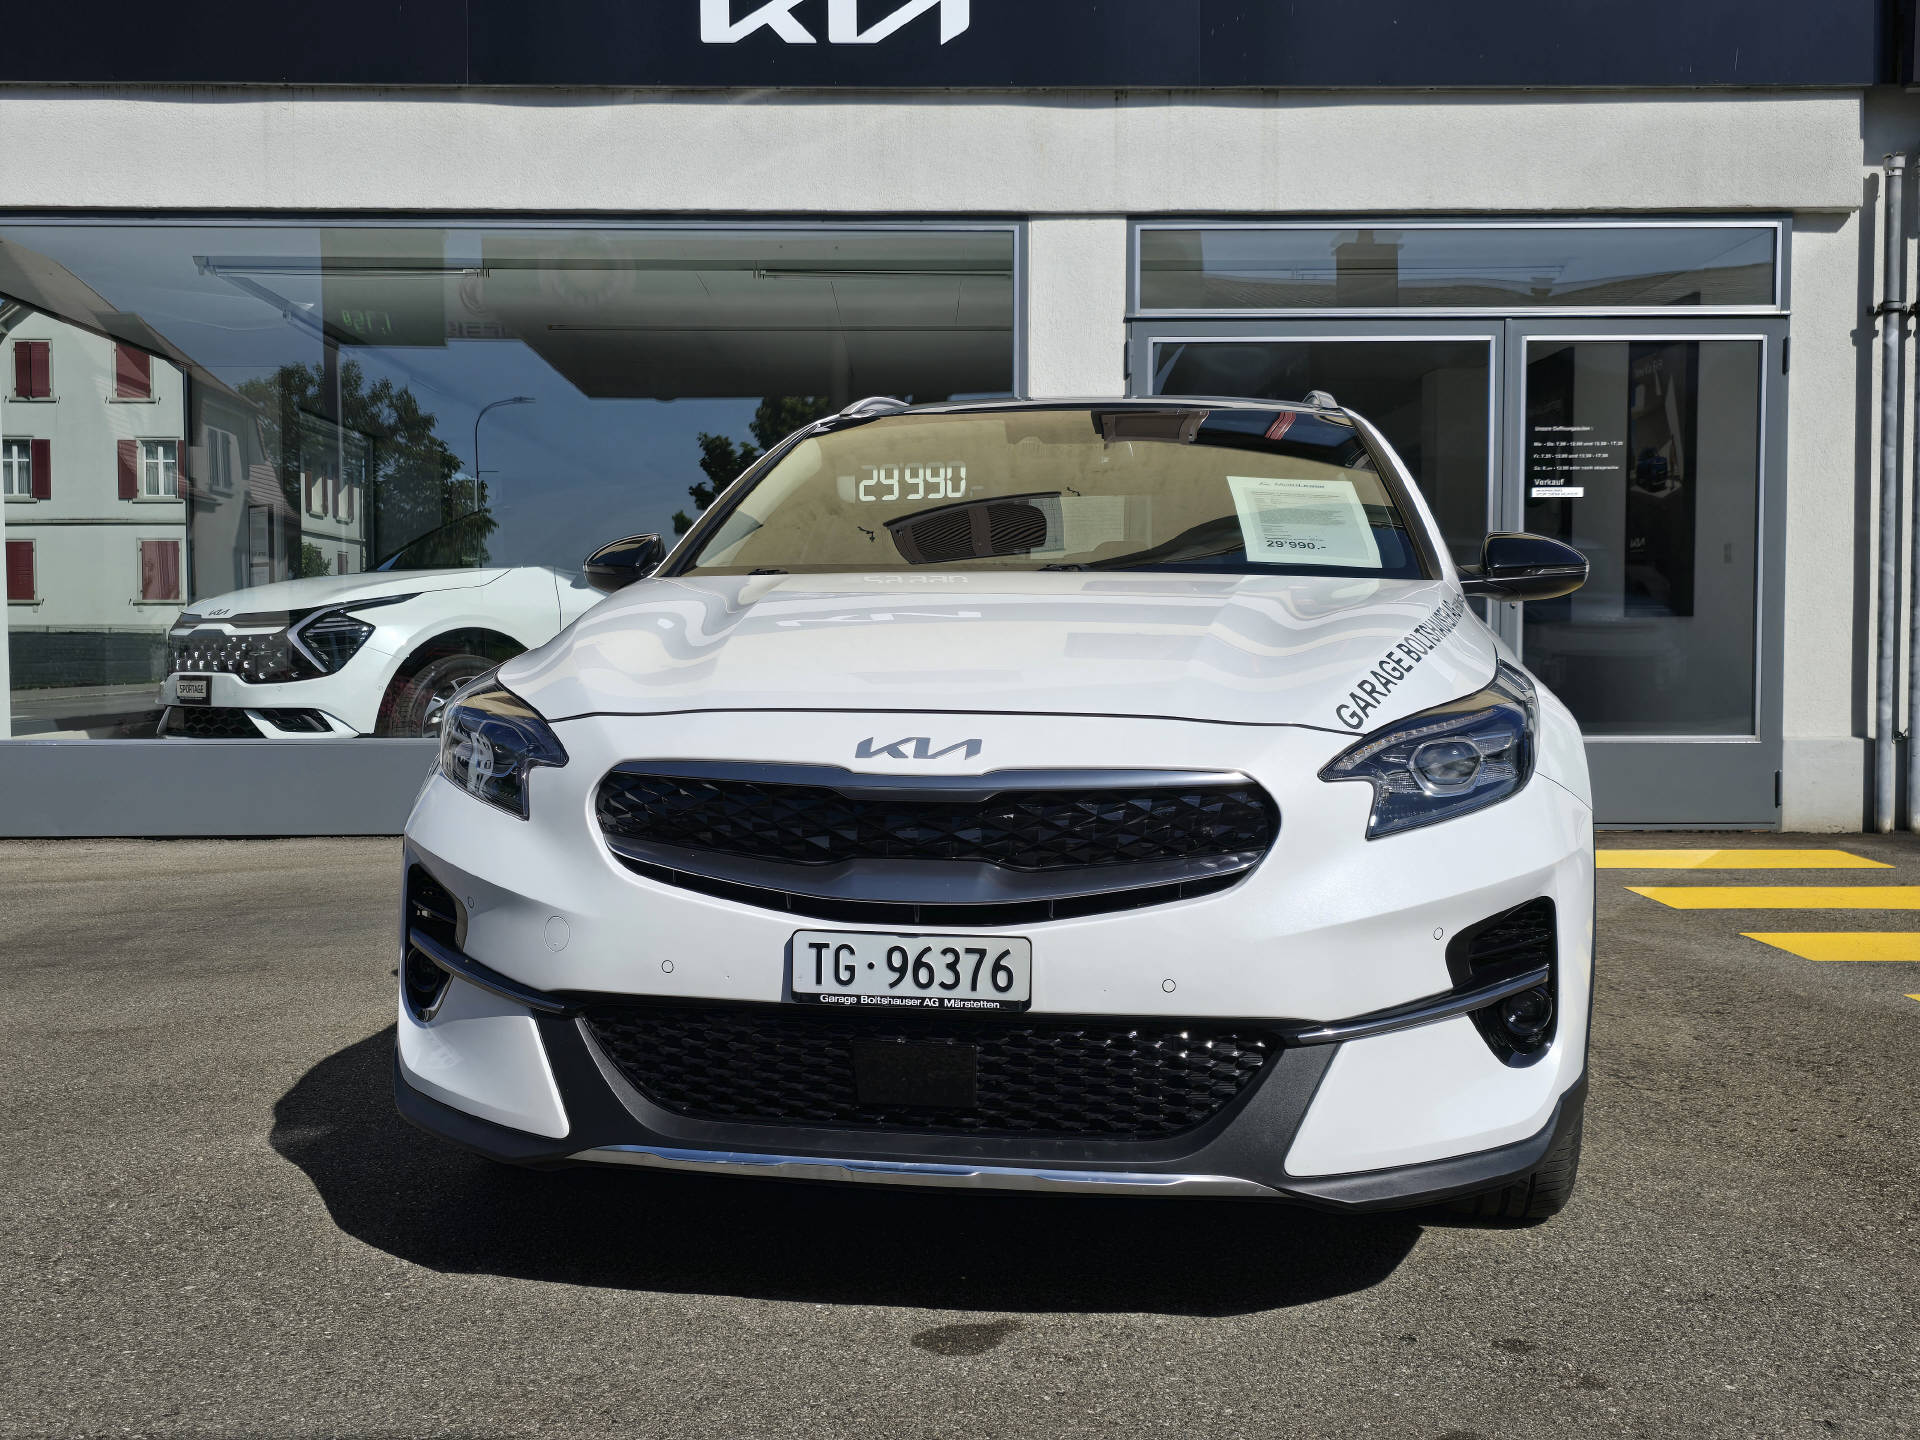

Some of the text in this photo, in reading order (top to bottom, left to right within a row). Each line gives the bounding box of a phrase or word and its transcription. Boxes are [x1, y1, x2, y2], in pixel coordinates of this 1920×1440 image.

[1534, 478, 1565, 486] Verkauf
[180, 684, 205, 694] SPORTAGE
[1336, 651, 1415, 730] GARAGE
[855, 737, 982, 760] KIA
[820, 994, 1000, 1009] Garage Boltshauser AG Märstetten
